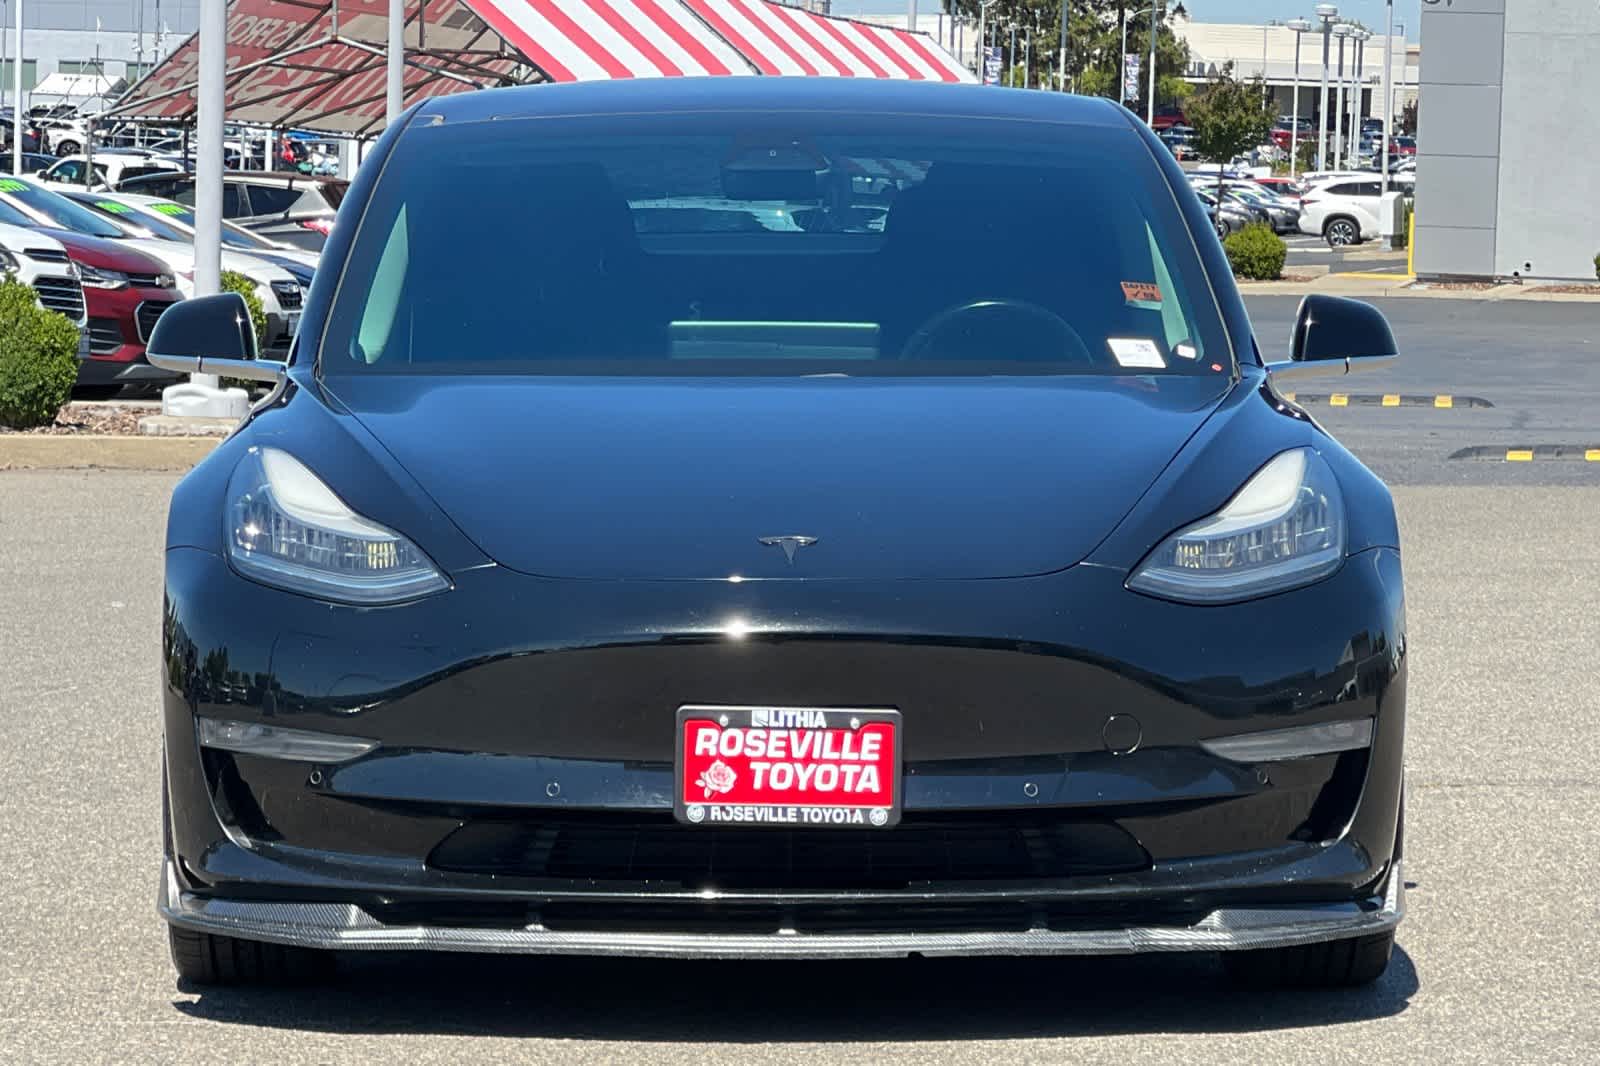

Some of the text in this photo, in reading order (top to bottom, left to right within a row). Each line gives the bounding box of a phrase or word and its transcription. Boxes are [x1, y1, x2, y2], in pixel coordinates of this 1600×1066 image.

[769, 710, 827, 728] LITHIA
[694, 728, 882, 761] ROSEVILLE
[750, 762, 881, 793] TOYOTA
[710, 807, 864, 824] ROSEVILLE TOYOTA
